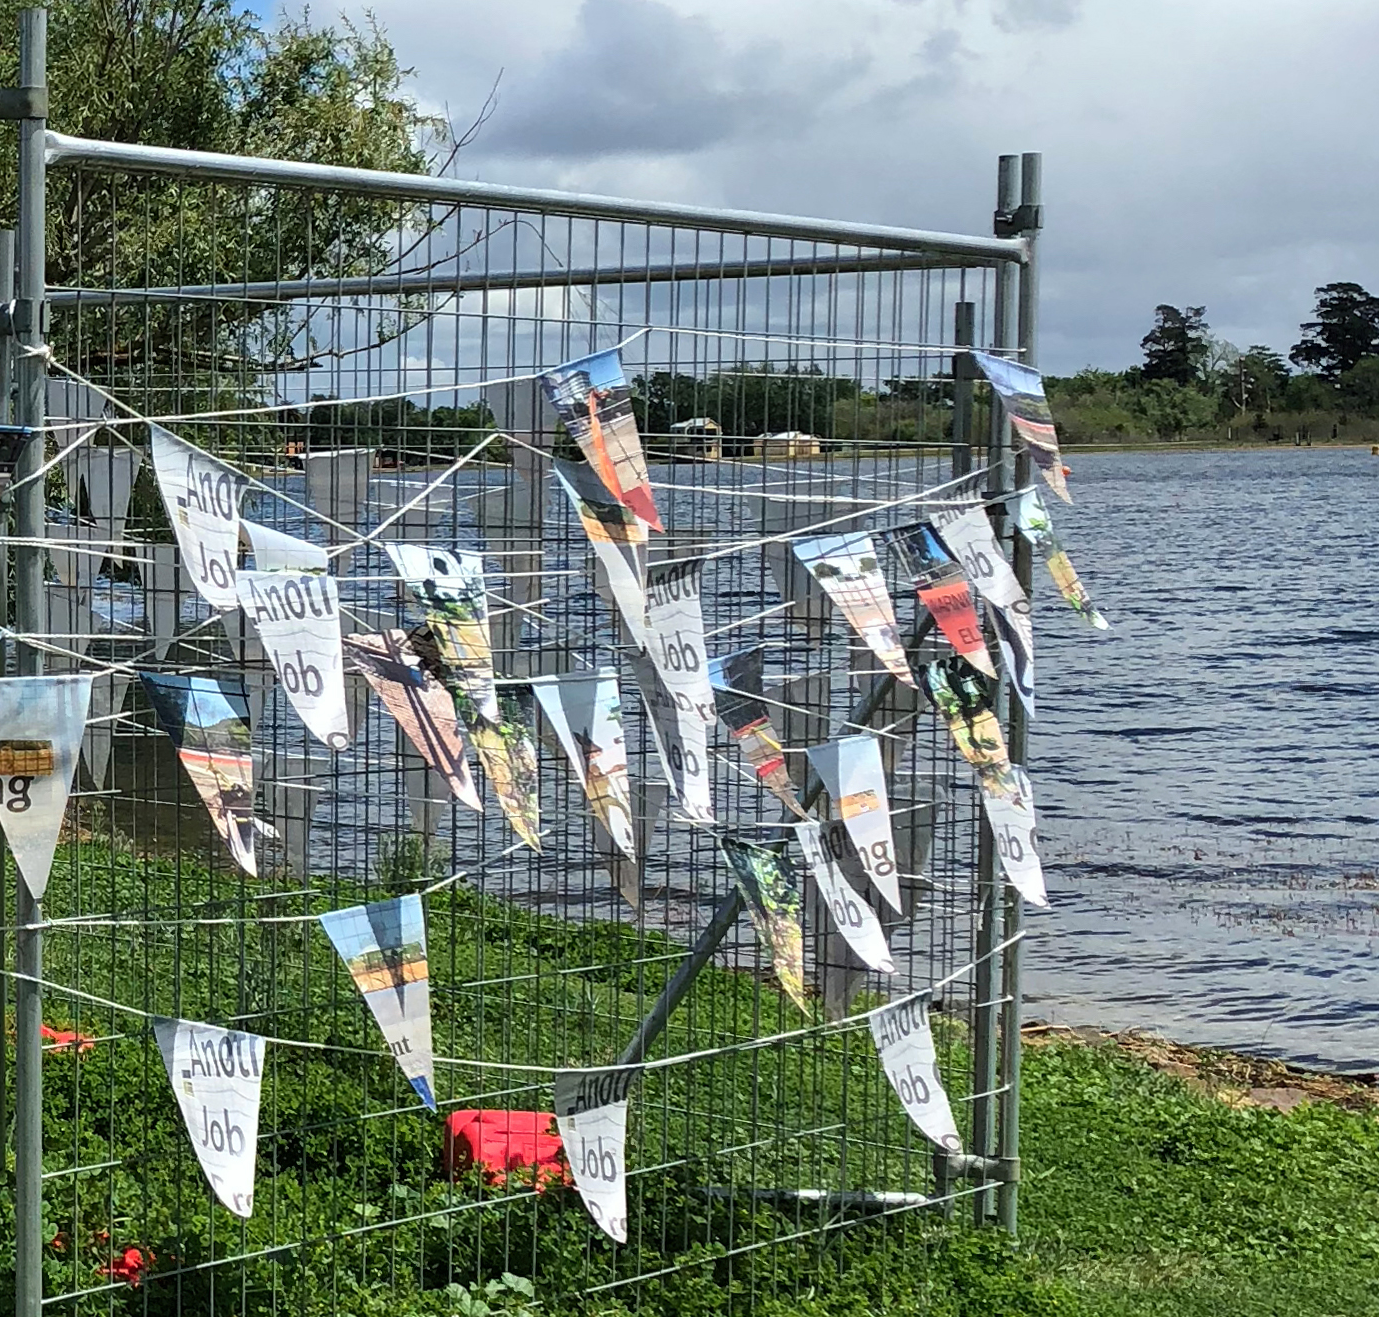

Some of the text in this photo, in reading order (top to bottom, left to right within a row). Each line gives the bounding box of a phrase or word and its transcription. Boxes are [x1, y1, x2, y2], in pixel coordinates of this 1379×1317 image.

[659, 629, 700, 673] Job
[202, 1105, 246, 1157] Job
[580, 1135, 617, 1183] Job
